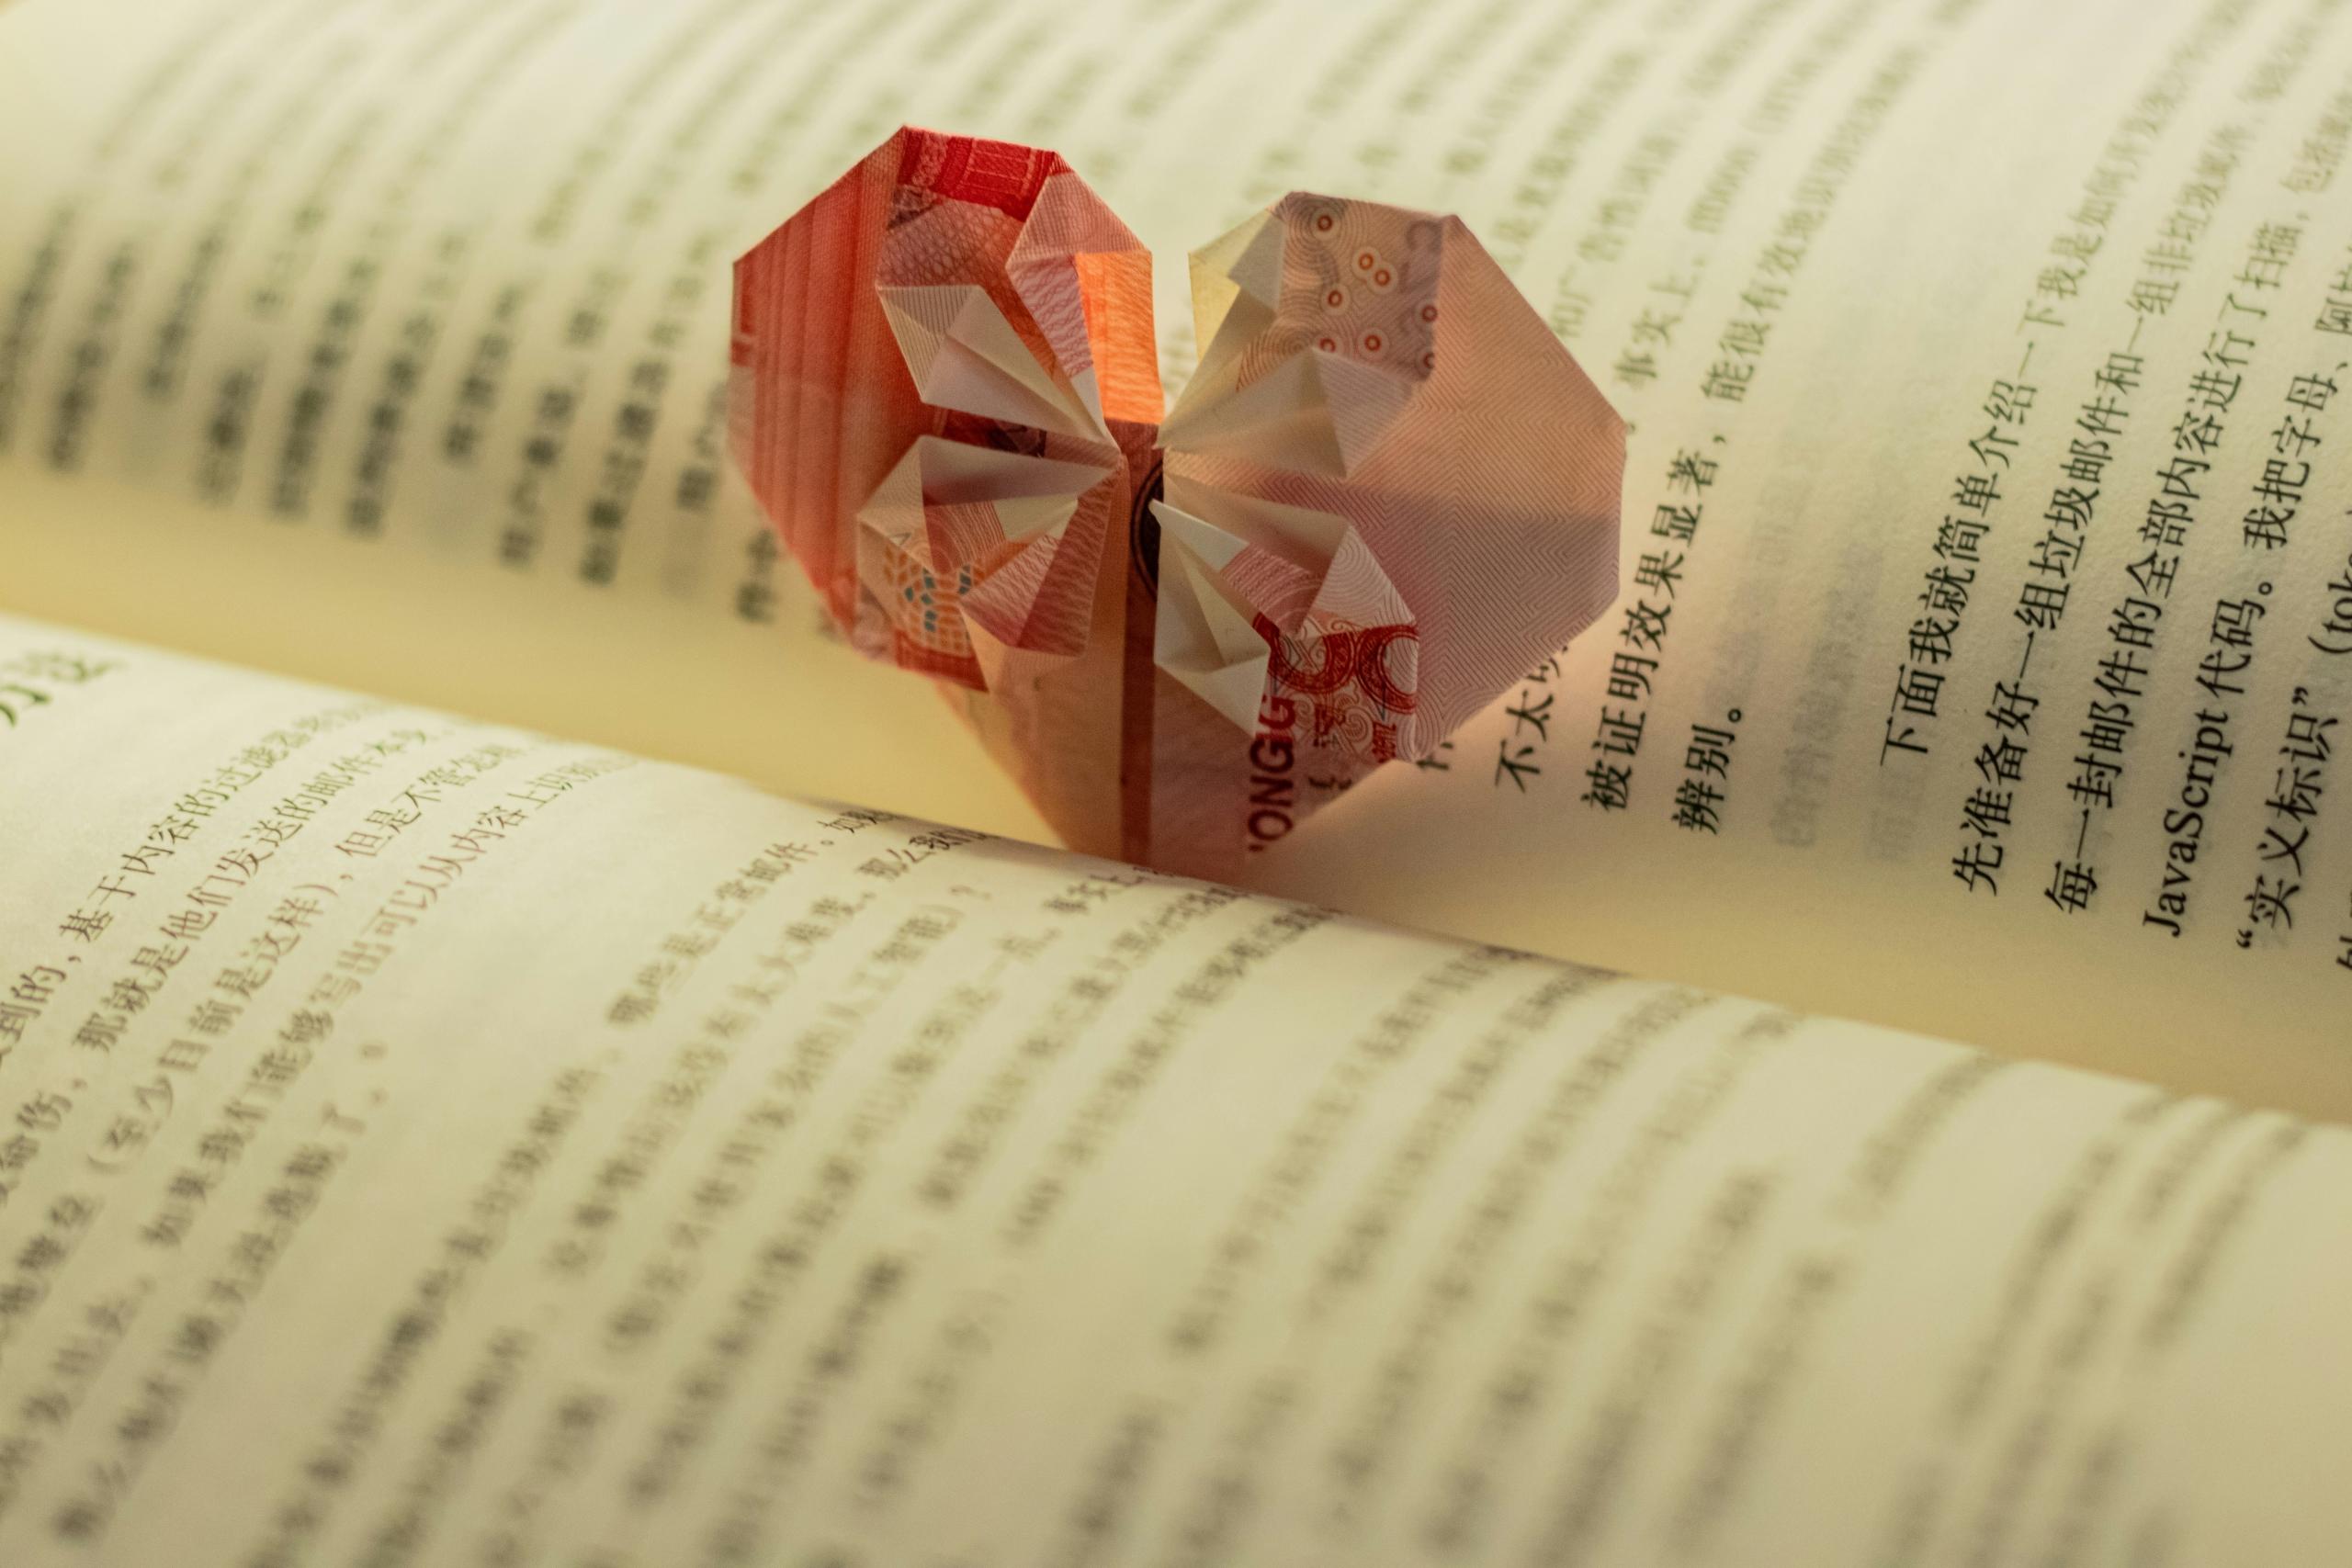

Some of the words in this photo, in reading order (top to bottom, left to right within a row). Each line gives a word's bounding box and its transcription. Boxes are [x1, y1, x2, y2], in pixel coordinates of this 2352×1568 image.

[1248, 694, 1297, 852] ONGG
[1672, 707, 1742, 836] 辨别。
[2143, 708, 2233, 937] JavaScript
